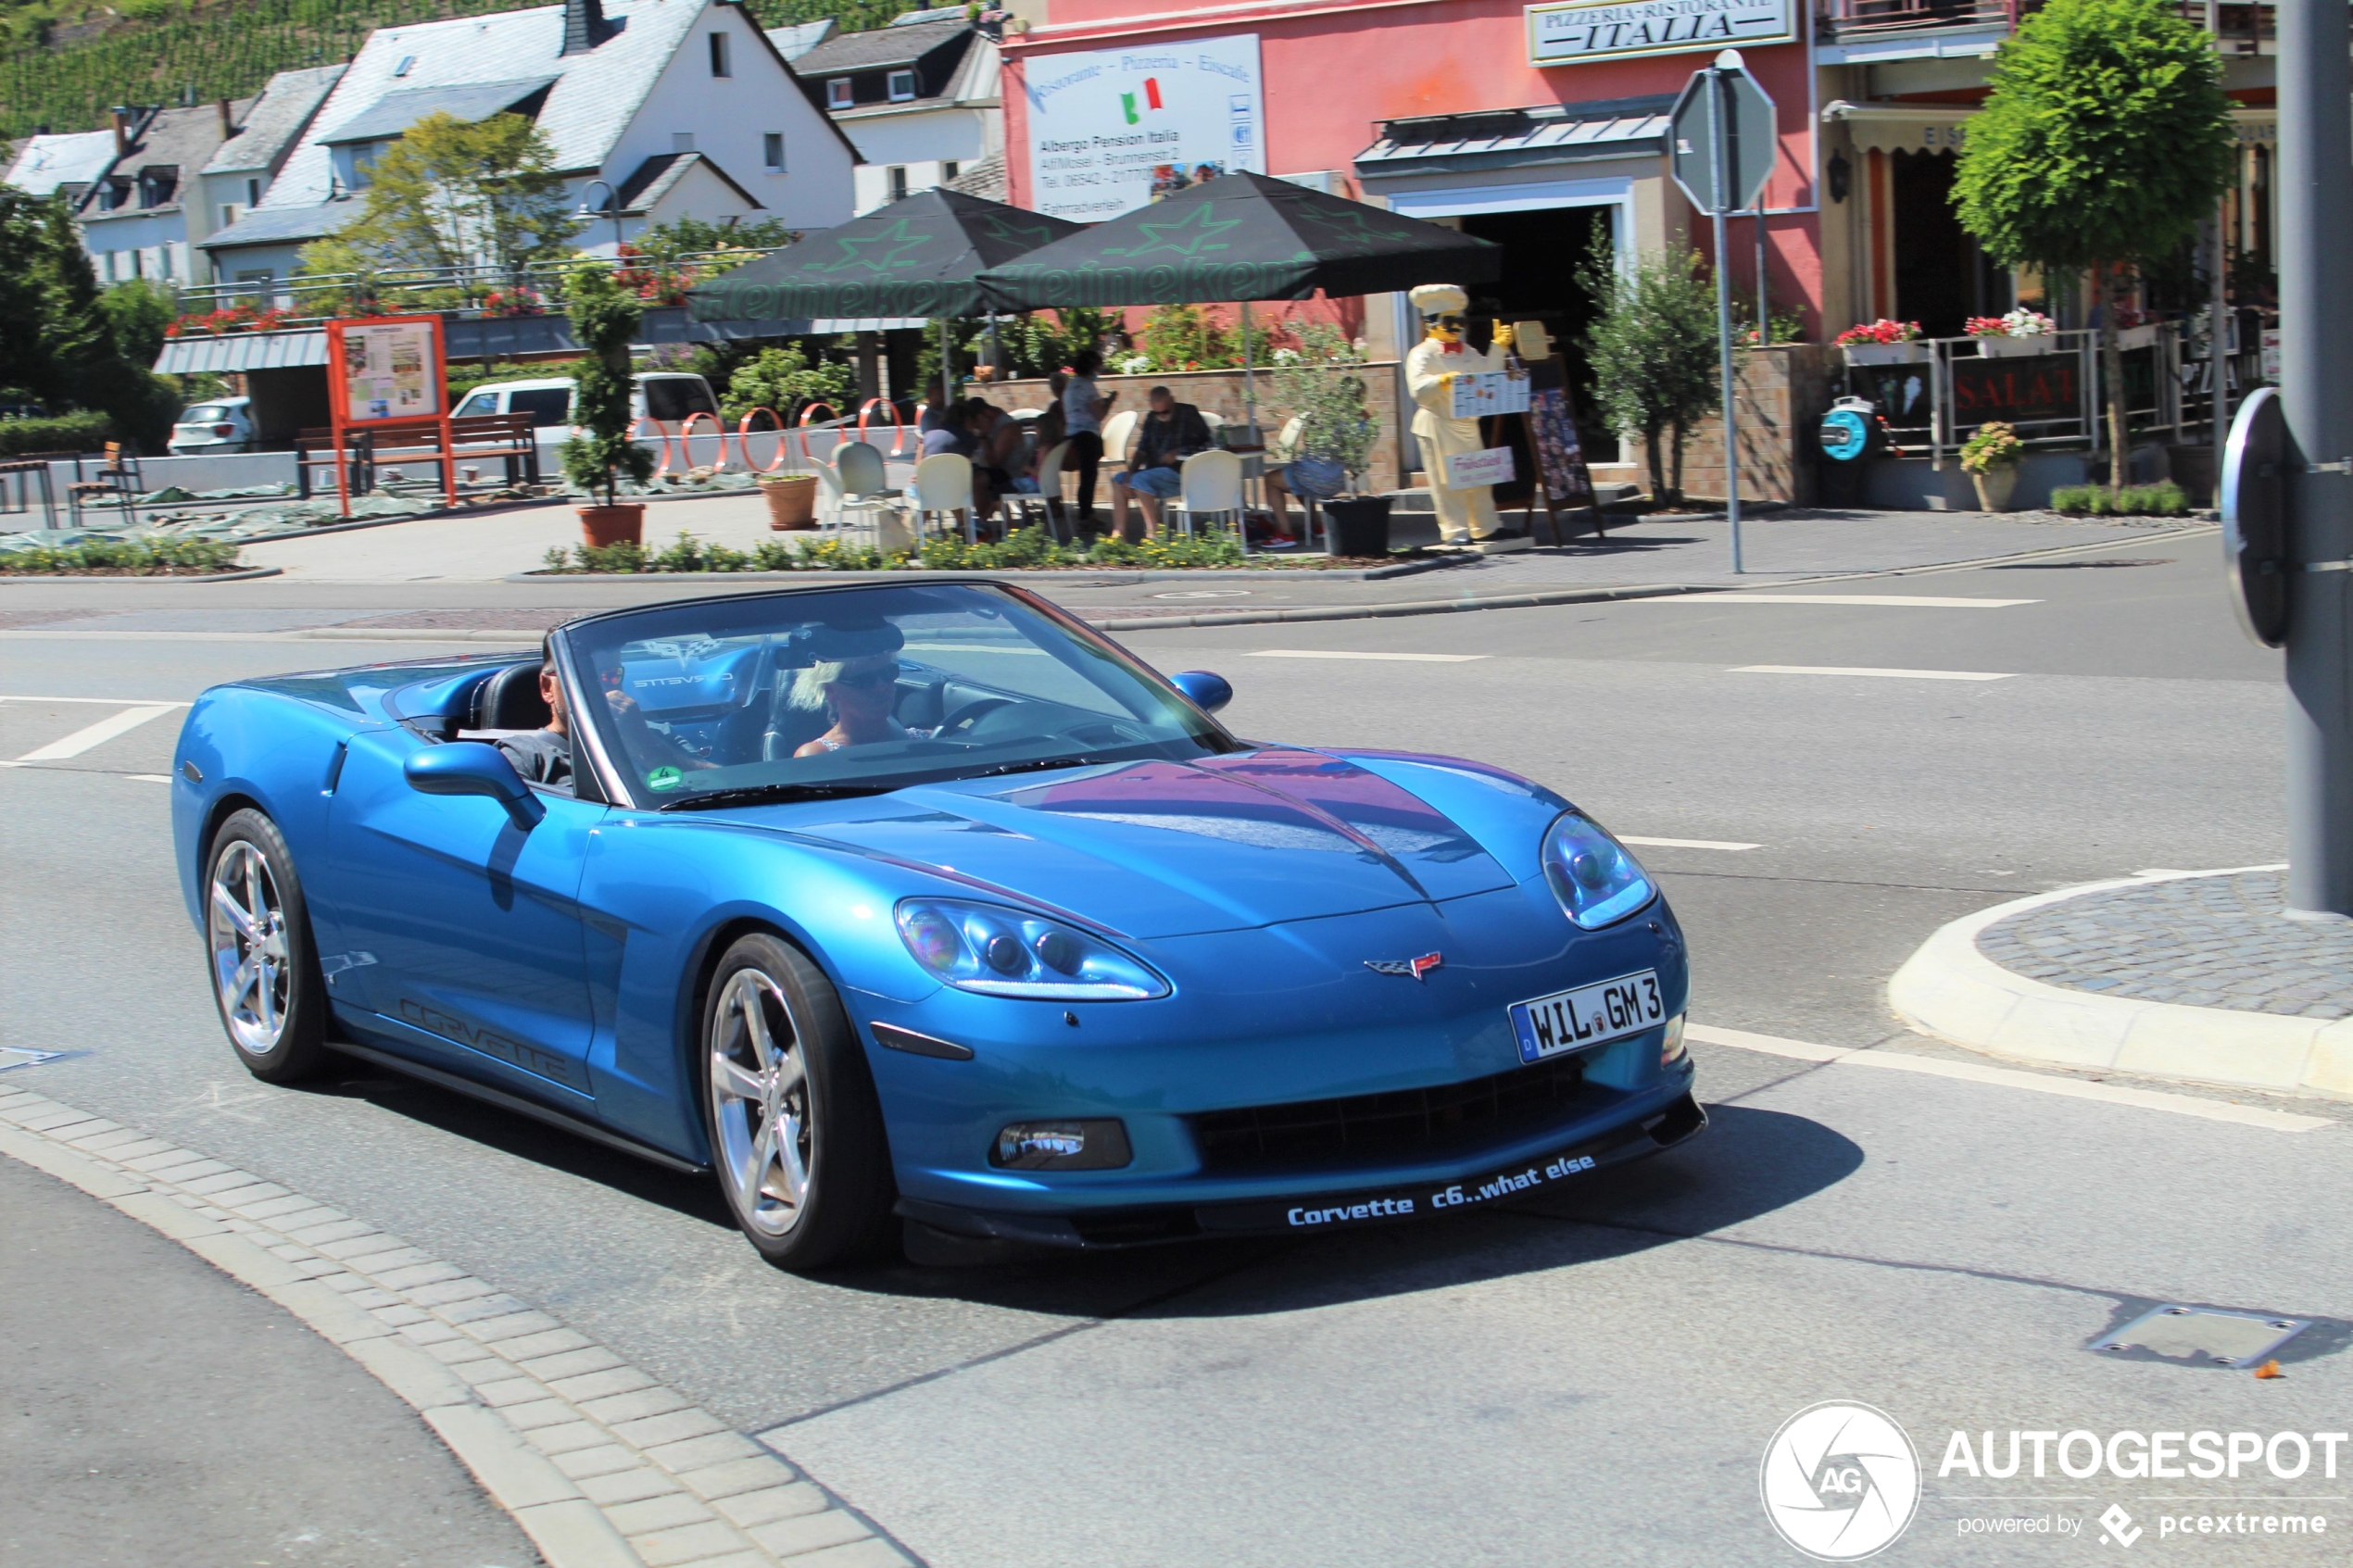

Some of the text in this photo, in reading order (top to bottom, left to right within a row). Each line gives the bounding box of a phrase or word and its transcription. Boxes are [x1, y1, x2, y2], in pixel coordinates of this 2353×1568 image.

[1583, 12, 1735, 50] ITALIA
[1122, 54, 1180, 71] Pizzeria
[1039, 130, 1180, 154] Albergo Pension Italia
[1041, 175, 1060, 189] Tel.
[698, 272, 975, 319] Heineken
[980, 254, 1304, 308] Heineken
[1956, 368, 2074, 409] SALAT
[659, 767, 671, 778] 4
[1523, 976, 1661, 1052] D WIL GM 3
[400, 997, 569, 1081] CORVETTE
[1288, 1198, 1415, 1226] Corvette
[1545, 1155, 1596, 1181] else
